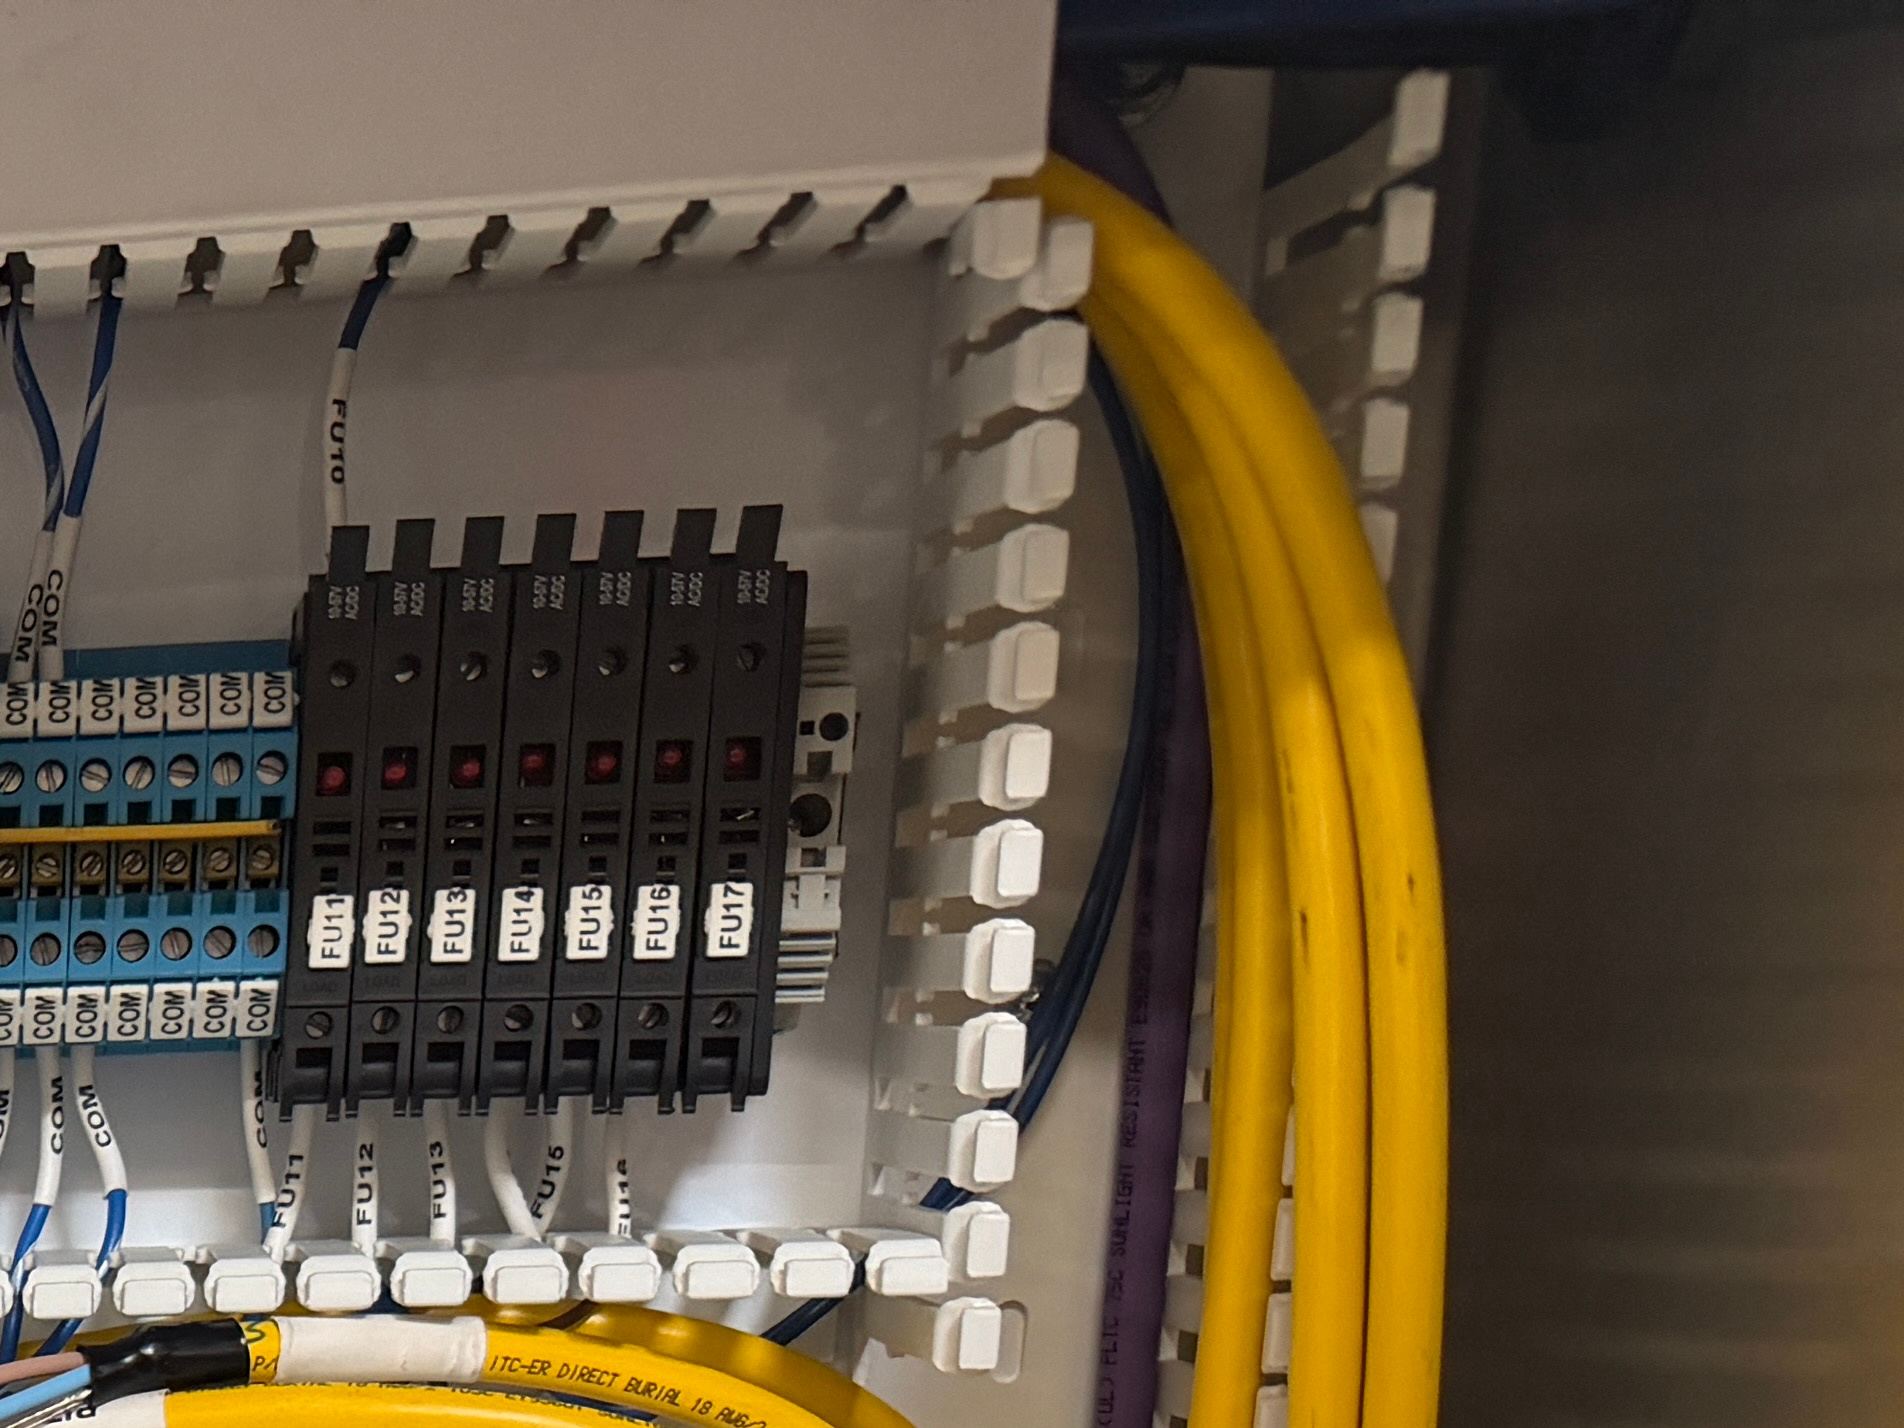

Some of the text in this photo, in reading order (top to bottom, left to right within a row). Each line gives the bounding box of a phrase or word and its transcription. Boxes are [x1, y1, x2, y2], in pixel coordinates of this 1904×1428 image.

[329, 399, 347, 484] FU10
[15, 584, 44, 663] COM
[42, 570, 64, 646] COM
[320, 896, 346, 961] FU11
[383, 891, 402, 958] FU12
[441, 889, 469, 956] FU13
[509, 888, 534, 955] FU14
[576, 886, 603, 953] FU15
[644, 886, 672, 953] FU16
[720, 883, 746, 950] FU17
[119, 993, 140, 1037] COM
[51, 1076, 65, 1155] COM
[78, 1084, 111, 1149] COM
[273, 1154, 305, 1228] FU11
[355, 1144, 374, 1226] FU12
[429, 1142, 448, 1219] FU13
[531, 1146, 564, 1219] FU15
[490, 1356, 551, 1377] ITC-ER
[557, 1362, 620, 1390] DIRECT
[624, 1376, 682, 1408] BURIAL
[691, 1396, 713, 1415] 18
